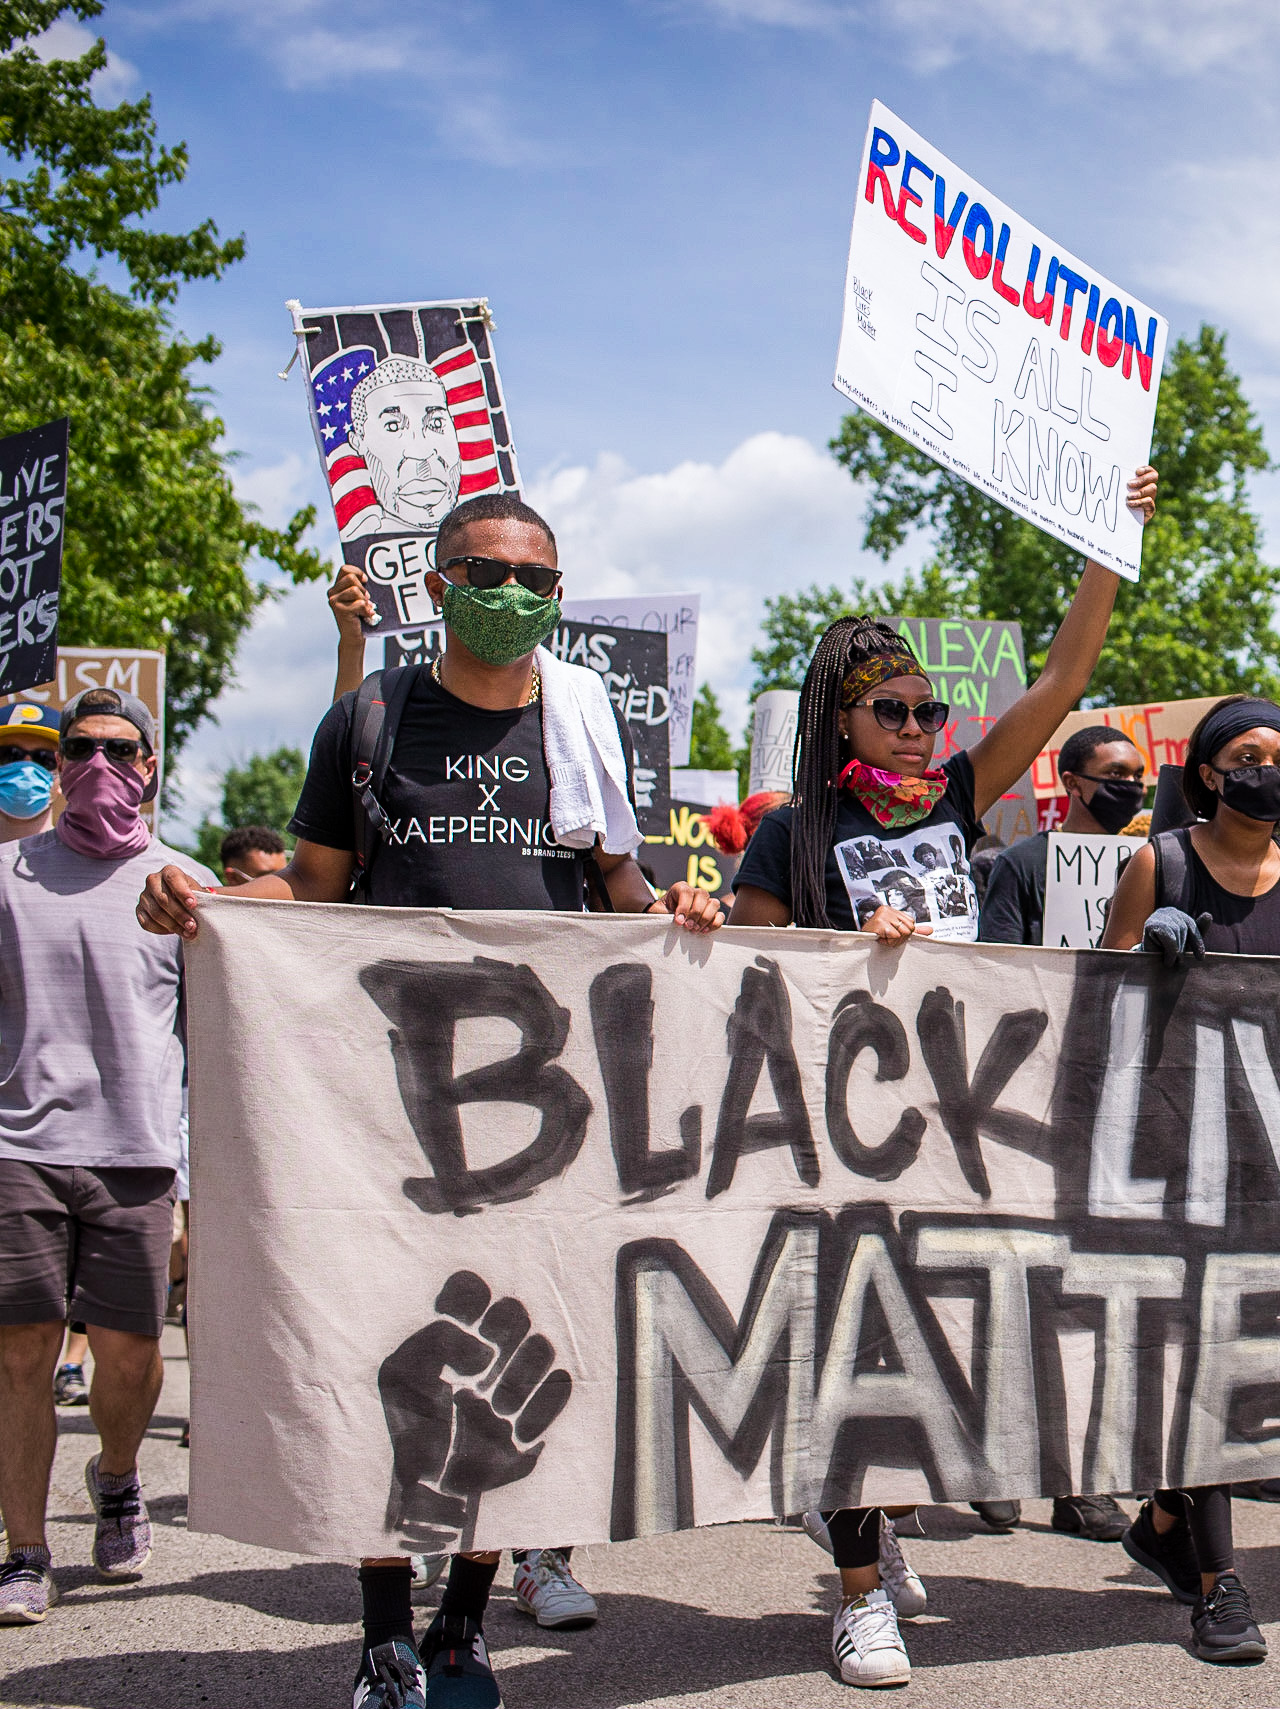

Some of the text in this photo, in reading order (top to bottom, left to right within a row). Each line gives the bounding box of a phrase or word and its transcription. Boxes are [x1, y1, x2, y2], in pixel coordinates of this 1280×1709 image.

[865, 127, 1157, 391] REVOLUTION
[916, 261, 1111, 441] IS ALL
[912, 350, 1121, 532] I KNOW
[0, 496, 64, 556] ERS
[0, 551, 45, 602] OT
[0, 591, 58, 652] ERS
[898, 620, 1027, 686] ALEXA
[932, 676, 989, 724] lay
[446, 756, 529, 782] KING
[478, 784, 500, 811] X
[388, 816, 560, 847] KAEPERNIC
[533, 848, 555, 857] BRAND
[557, 850, 571, 859] TEES
[687, 855, 723, 892] IS
[1056, 844, 1108, 886] MY
[360, 954, 1052, 1214] BLACK
